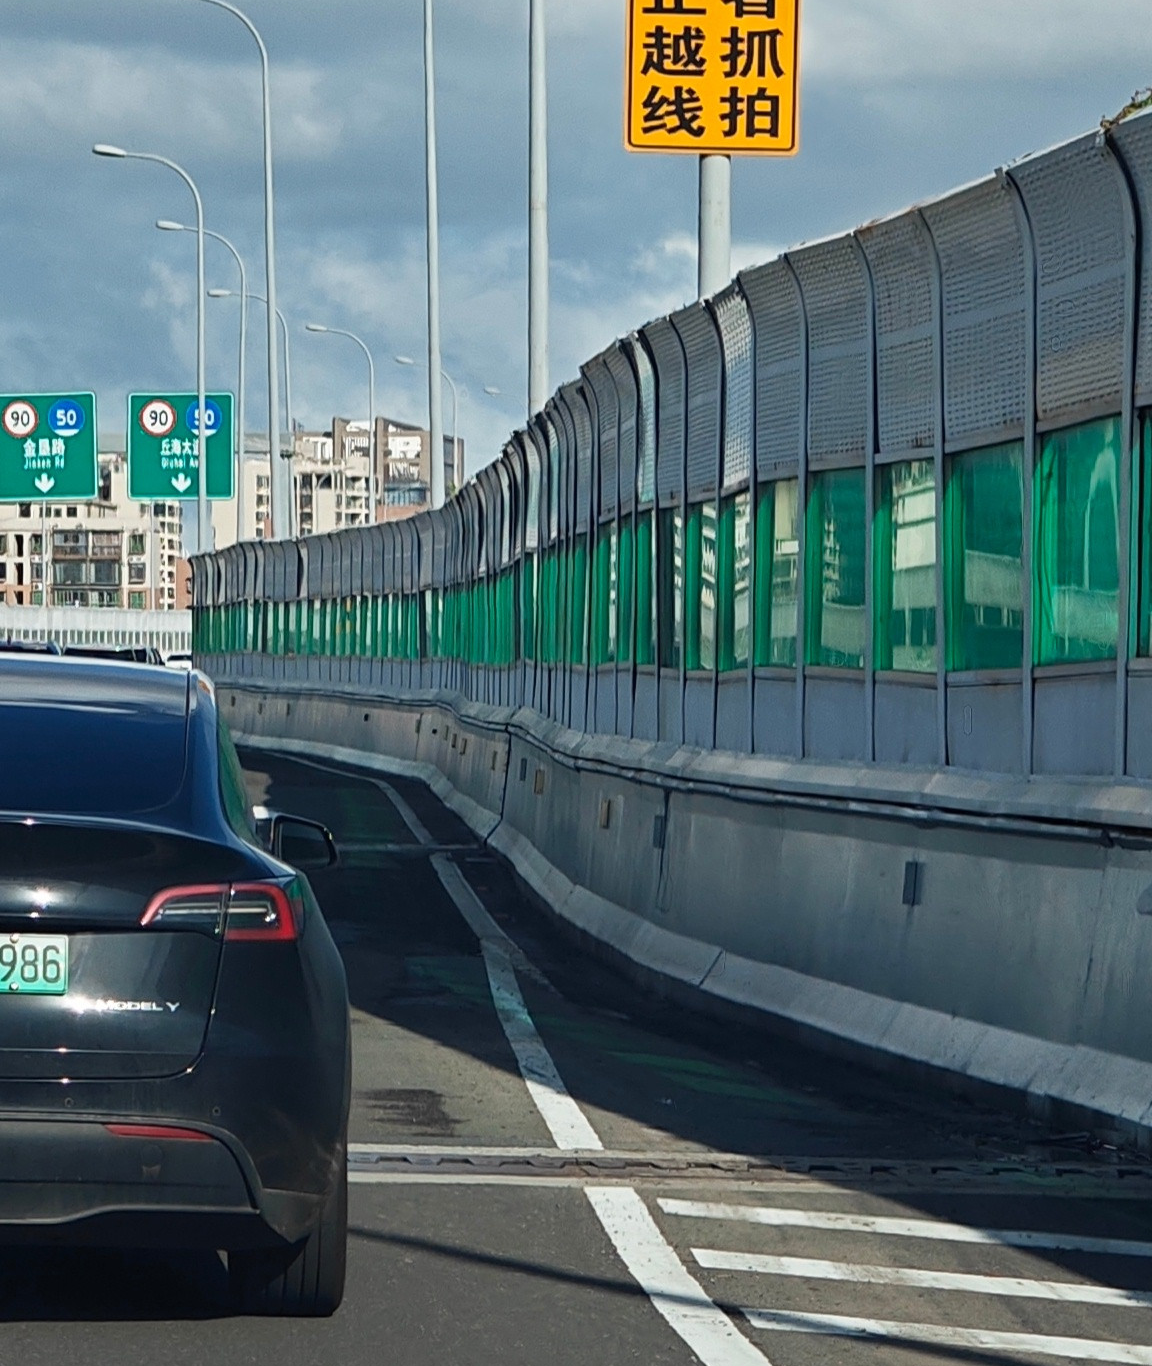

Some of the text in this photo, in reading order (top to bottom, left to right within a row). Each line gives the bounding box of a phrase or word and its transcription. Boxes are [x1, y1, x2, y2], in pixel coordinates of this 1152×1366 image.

[10, 410, 30, 427] 90
[55, 408, 77, 426] 50
[149, 410, 168, 426] 90
